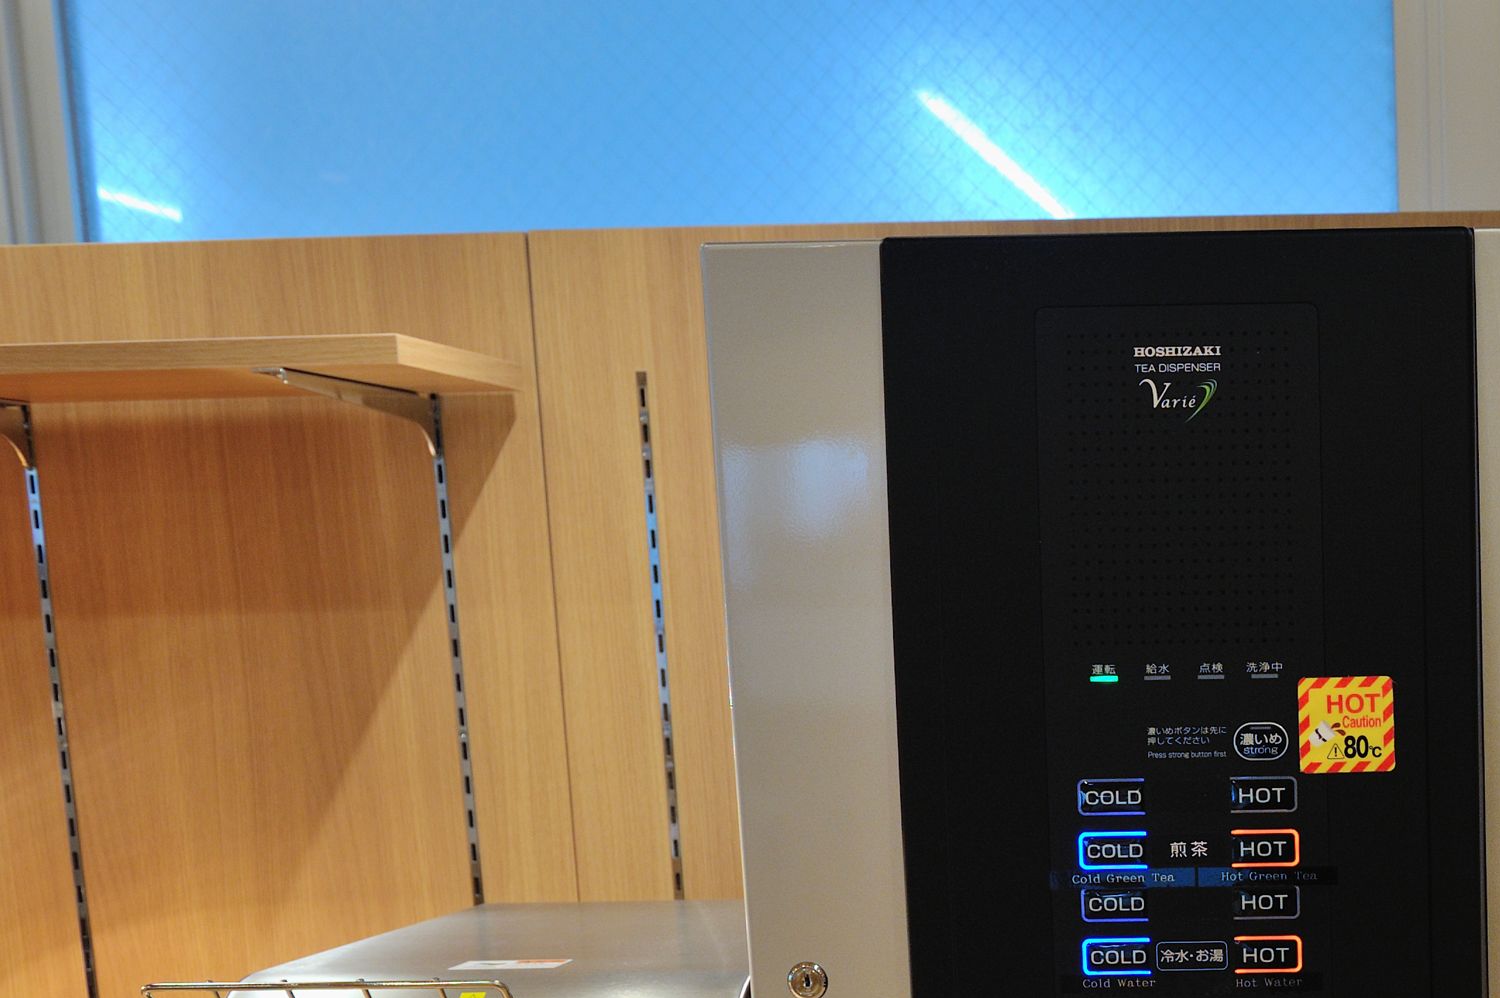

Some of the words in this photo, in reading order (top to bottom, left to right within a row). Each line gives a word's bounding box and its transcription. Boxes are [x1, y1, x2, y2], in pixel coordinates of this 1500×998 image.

[1134, 346, 1222, 358] HOSHIZAKI
[1134, 364, 1156, 373] TEA
[1158, 362, 1221, 373] DISPENSER
[1138, 378, 1197, 408] Varié
[1091, 664, 1116, 675] 運転
[1146, 663, 1170, 674] 給水
[1200, 662, 1224, 673] 点検
[1246, 661, 1283, 673] 洗浄中
[1326, 693, 1380, 714] HOT
[1342, 715, 1381, 728] Caution
[1147, 736, 1210, 745] 押してください
[1239, 732, 1282, 746] 濃いめ
[1243, 746, 1278, 755] strong
[1085, 790, 1142, 805] COLD
[1238, 788, 1286, 804] HOT
[1087, 844, 1143, 858] COLD
[1170, 841, 1208, 858] 煎茶
[1240, 841, 1287, 857] HOT
[1072, 874, 1102, 884] Cold
[1106, 873, 1145, 883] Green
[1152, 872, 1175, 882] Tea
[1221, 872, 1243, 881] Hot
[1249, 871, 1287, 880] Green
[1294, 872, 1317, 880] Tea
[1088, 897, 1145, 911] COLD
[1241, 894, 1288, 910] HOT
[1090, 950, 1146, 965] COLD
[1160, 949, 1224, 963] 冷水・お湯
[1243, 948, 1290, 963] HOT
[1082, 979, 1113, 988] Cold
[1117, 978, 1156, 988] Water
[1236, 978, 1258, 988] Hot
[1264, 977, 1303, 987] Water
